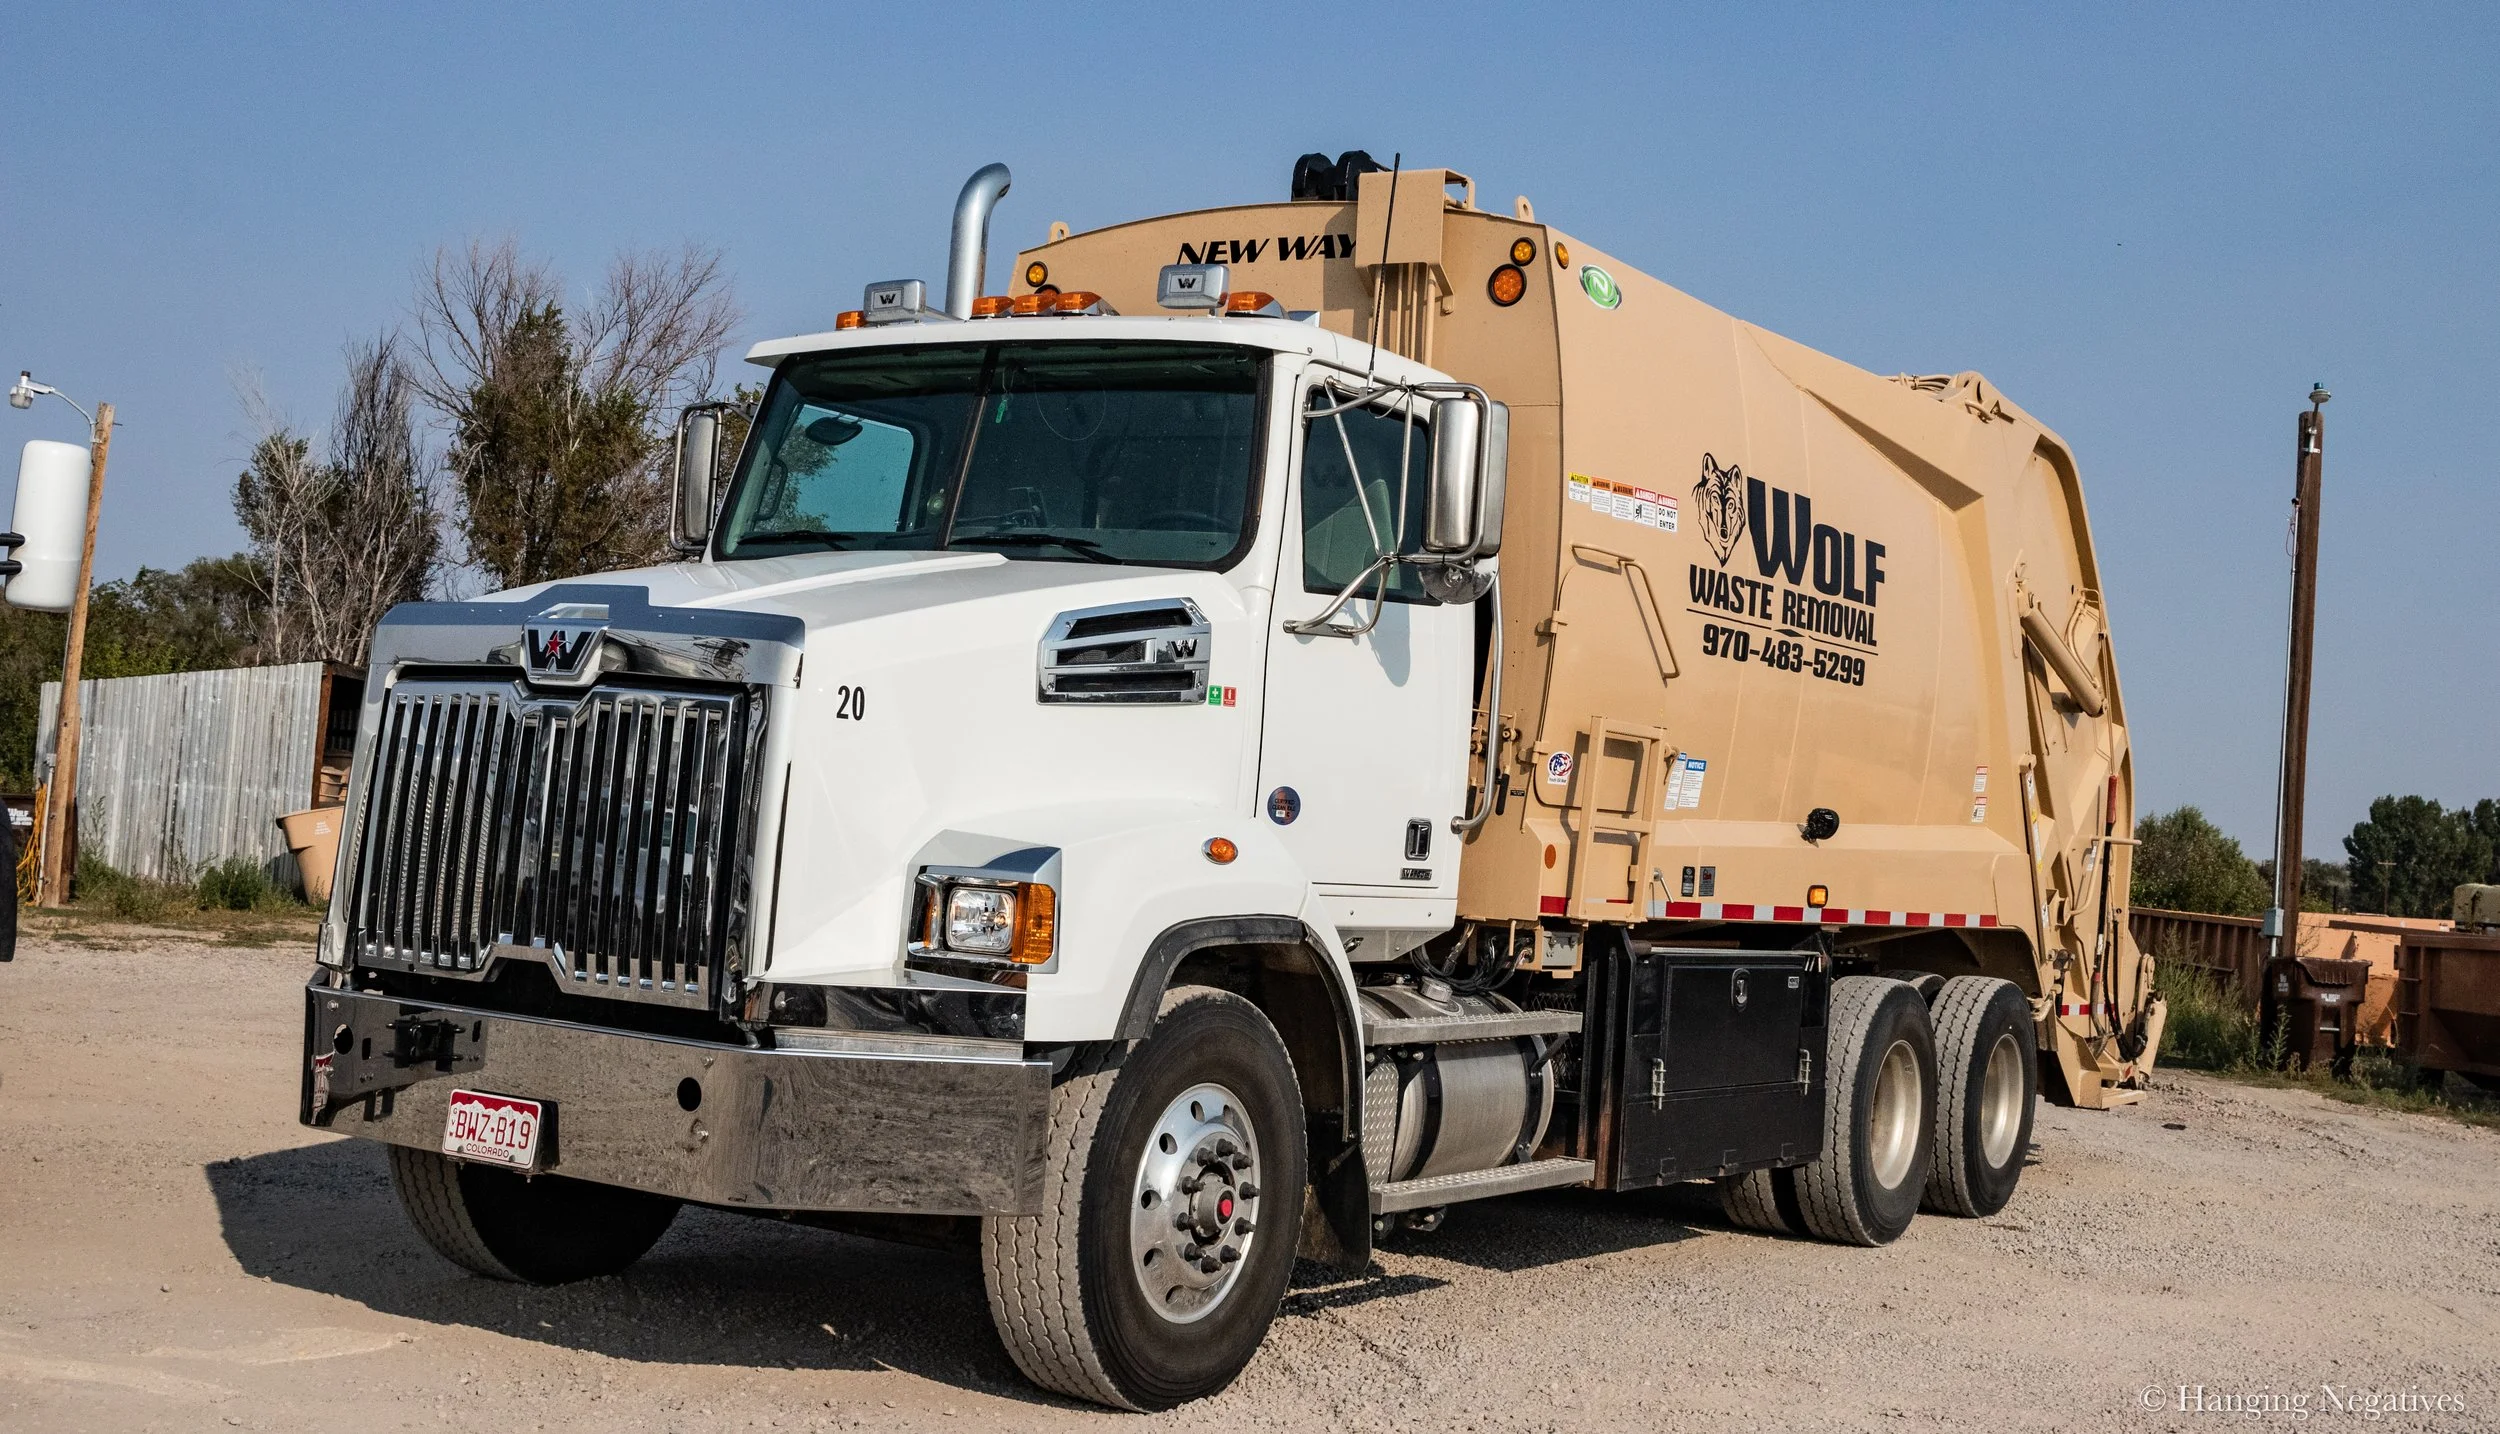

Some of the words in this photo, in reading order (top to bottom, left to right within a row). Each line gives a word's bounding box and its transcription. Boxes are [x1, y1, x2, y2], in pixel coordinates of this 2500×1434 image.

[1177, 238, 1270, 265] NEW
[1278, 233, 1356, 261] WAY
[1658, 507, 1666, 517] DO
[1666, 510, 1677, 520] NOT
[1659, 519, 1676, 530] ENTER
[1747, 476, 1886, 608] WOLF
[1689, 564, 1774, 621] WASTE
[1781, 588, 1877, 647] REMOVAL
[1702, 623, 1866, 687] 970-483-5299
[836, 685, 865, 721] 20
[466, 1143, 510, 1159] COLORADO
